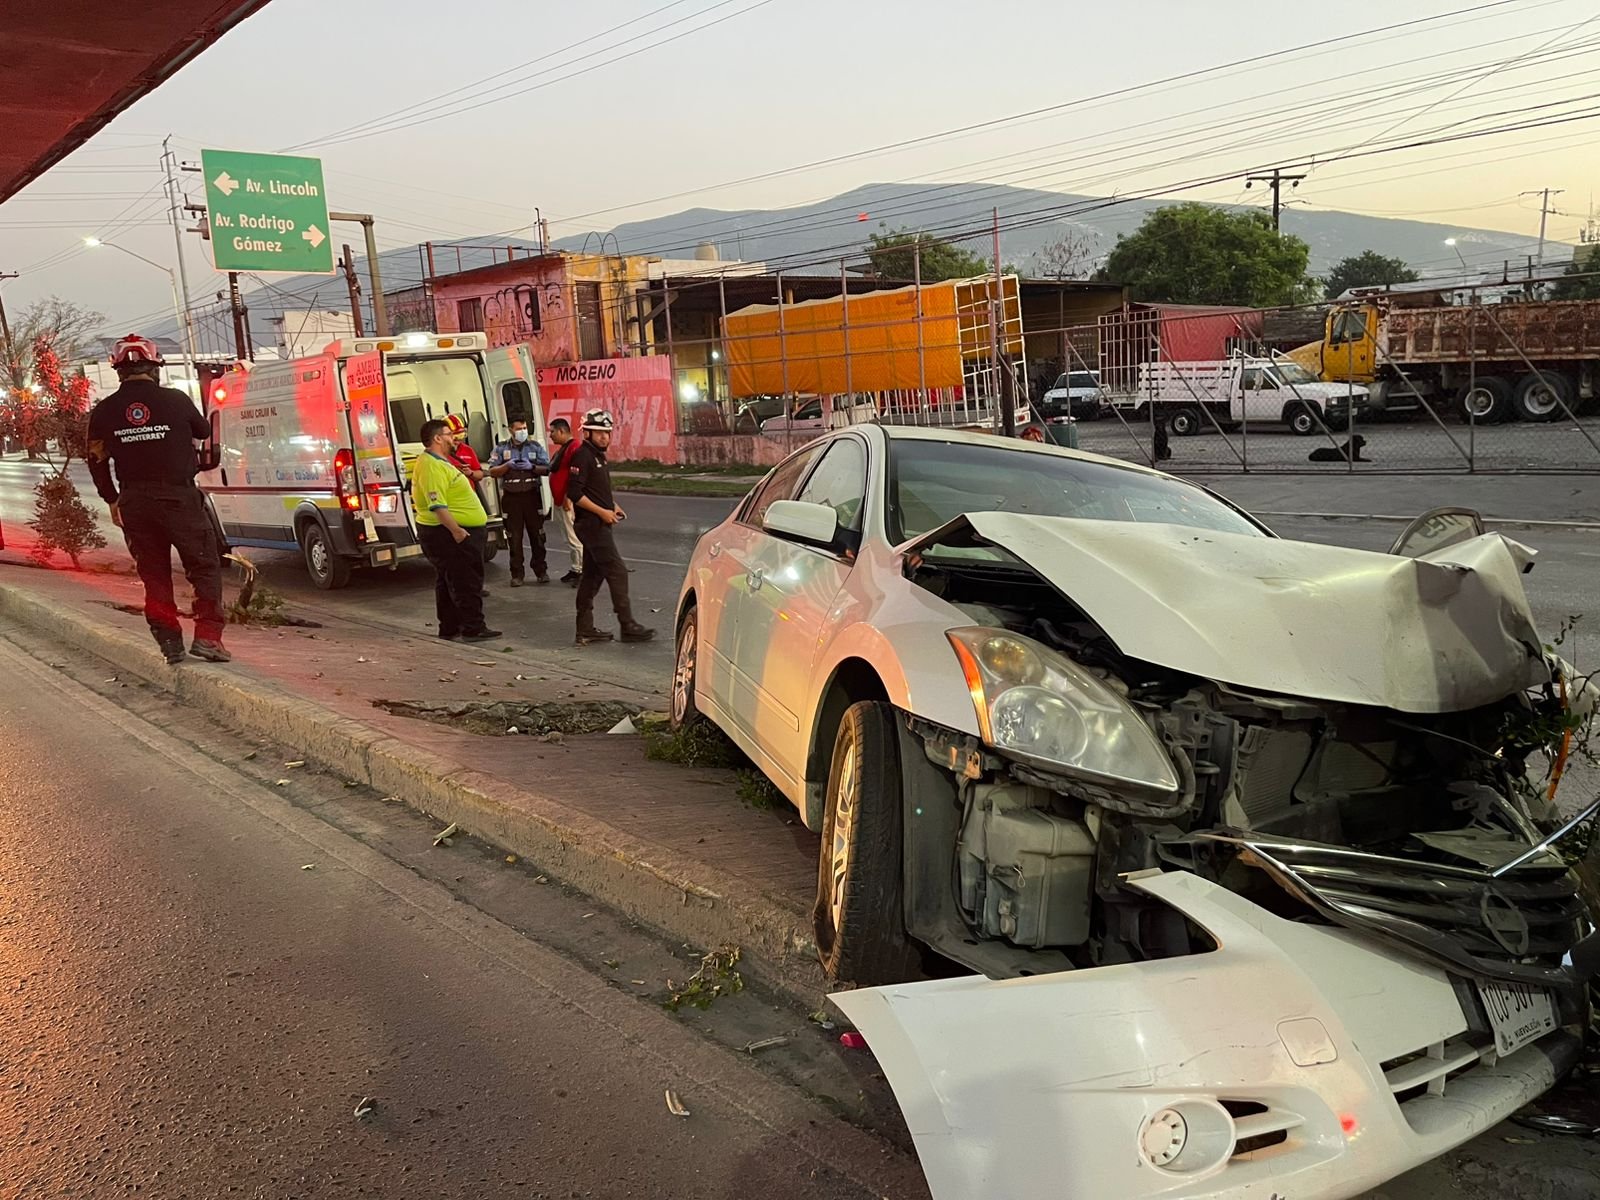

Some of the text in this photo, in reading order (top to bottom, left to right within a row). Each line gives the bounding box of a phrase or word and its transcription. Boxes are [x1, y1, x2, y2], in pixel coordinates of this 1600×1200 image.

[246, 179, 318, 196] Av. Lincoln
[215, 213, 294, 234] Av. Rodrigo
[233, 236, 282, 252] Gómez
[556, 363, 616, 381] MORENO
[113, 424, 171, 437] PROTECCIÓN CIVIL
[121, 432, 166, 443] MONTERREY
[245, 425, 266, 438] SALUD
